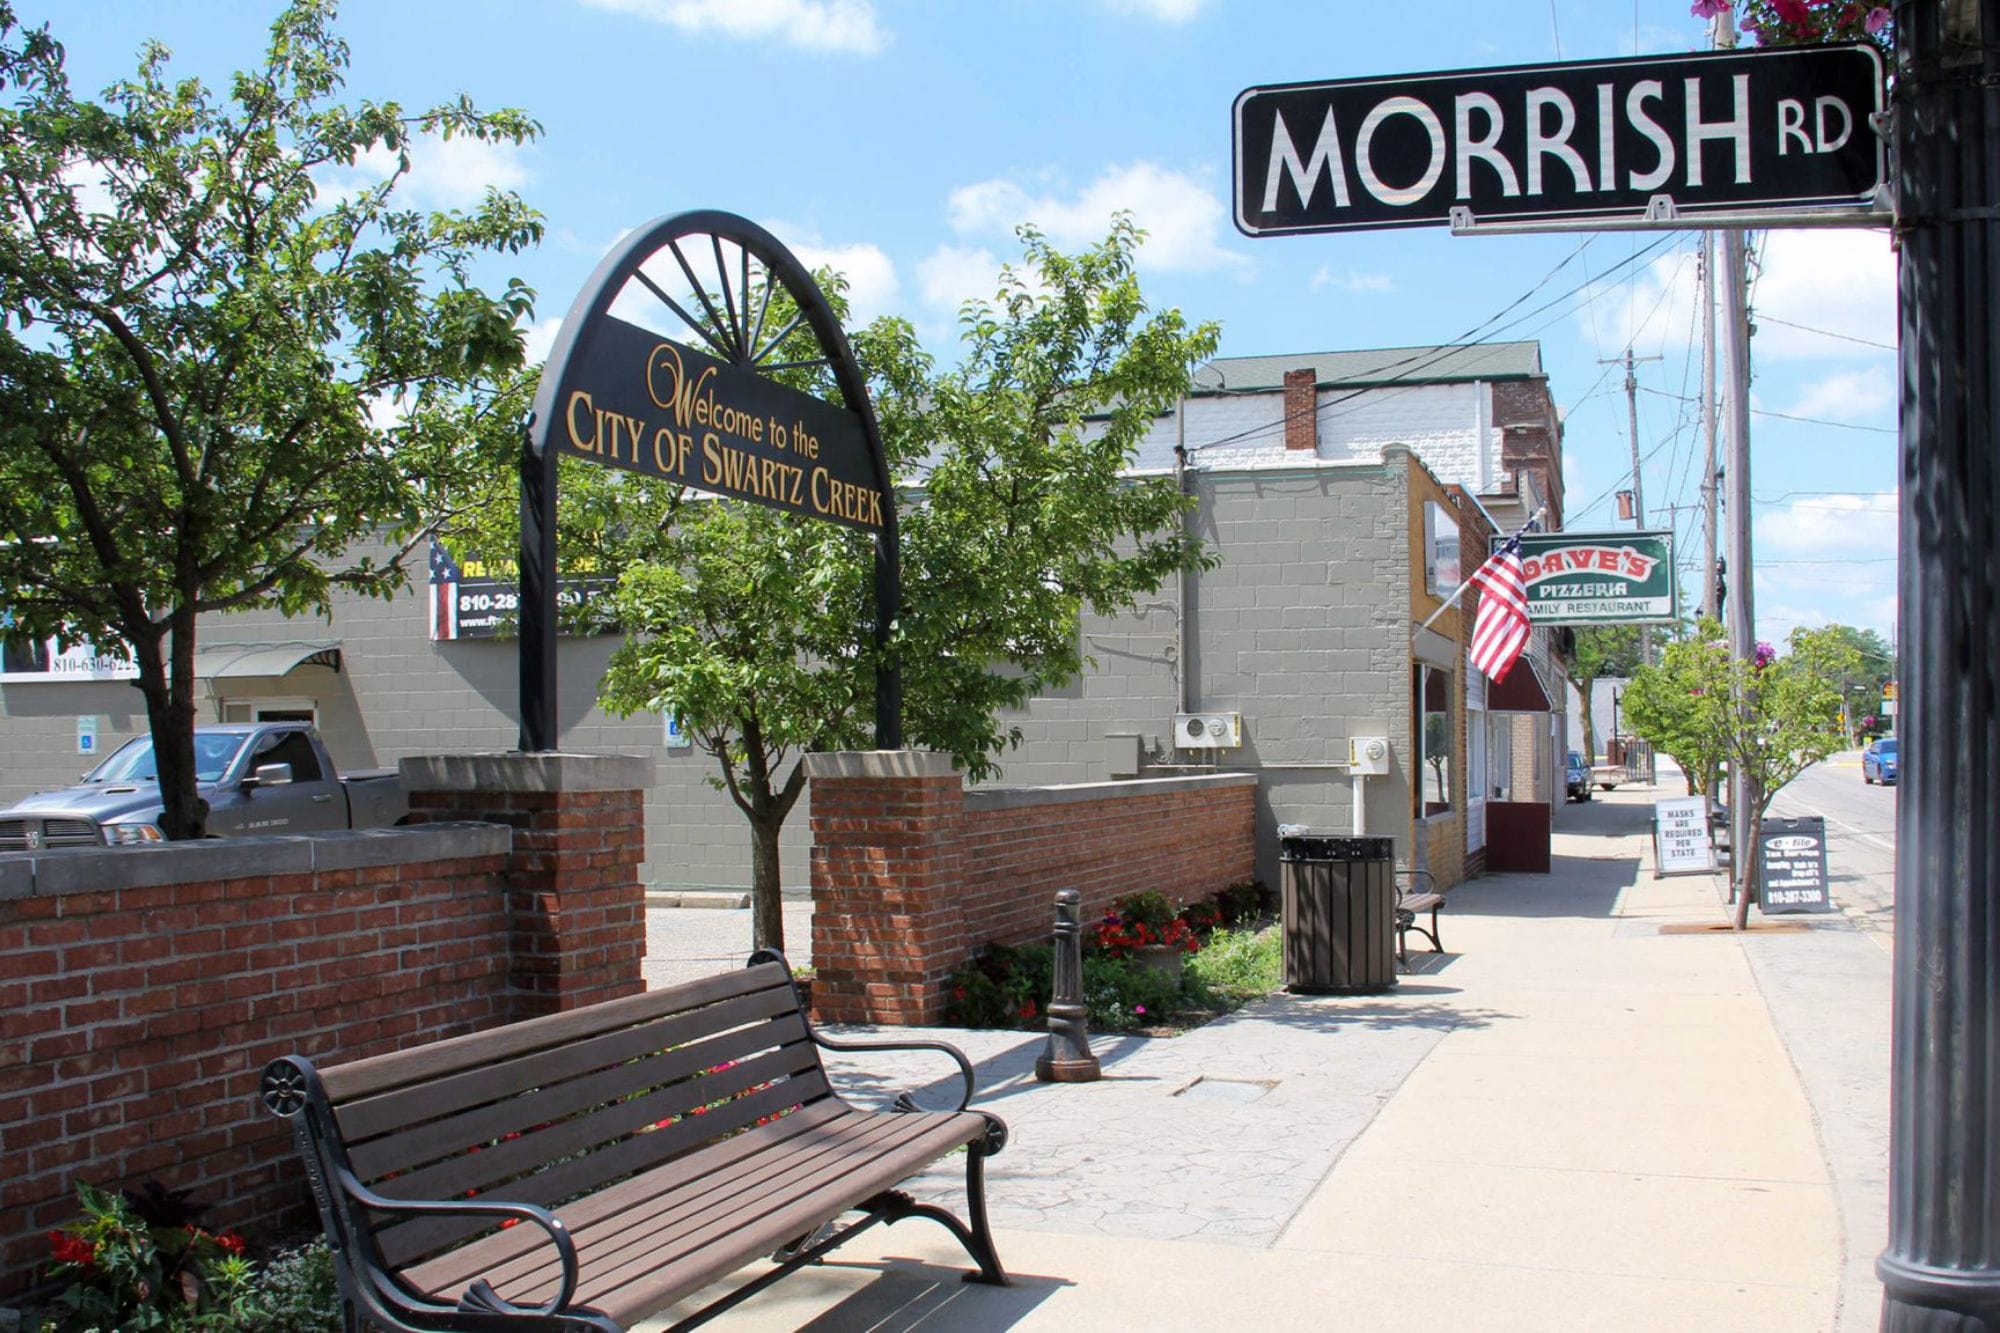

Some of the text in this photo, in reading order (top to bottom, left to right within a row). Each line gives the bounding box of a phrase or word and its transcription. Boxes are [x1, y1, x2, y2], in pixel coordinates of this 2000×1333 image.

[1261, 73, 1853, 212] MORRISH RD
[647, 343, 820, 461] Welcome to the
[566, 390, 884, 527] CITY OF SWARTZ CREEK
[1523, 548, 1650, 582] DAVE'S
[1539, 582, 1628, 599] PIZZERIA
[1526, 600, 1652, 615] AMILY RESTAURANT
[1666, 809, 1696, 818] MASKS
[1675, 819, 1690, 828] ARE
[1664, 829, 1703, 838] REQUIRED
[1675, 839, 1691, 848] PER
[1670, 848, 1696, 858] STATE
